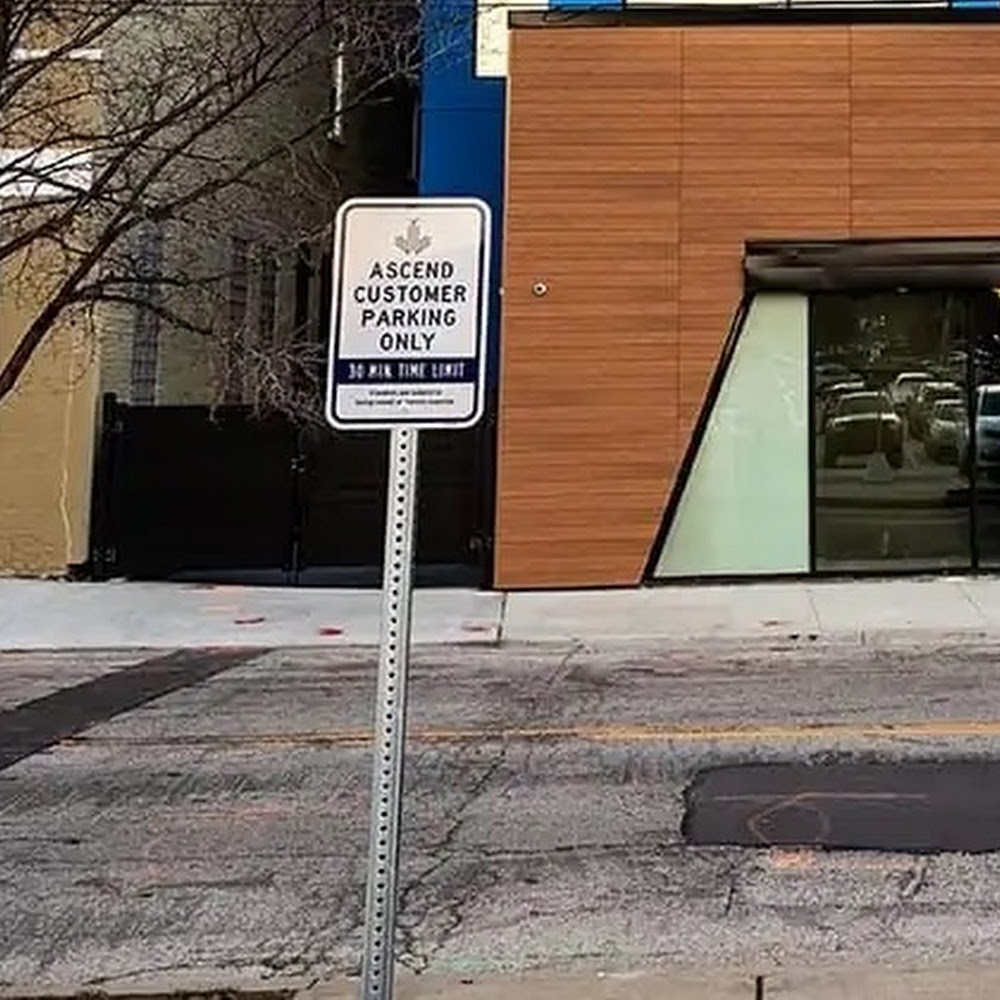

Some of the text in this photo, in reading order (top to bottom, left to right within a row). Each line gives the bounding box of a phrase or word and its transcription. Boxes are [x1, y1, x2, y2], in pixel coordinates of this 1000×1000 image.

[369, 261, 454, 279] ASCEND
[354, 285, 467, 303] CUSTOMER
[361, 309, 457, 327] PARKING
[379, 333, 436, 351] ONLY
[399, 362, 425, 379] TIME
